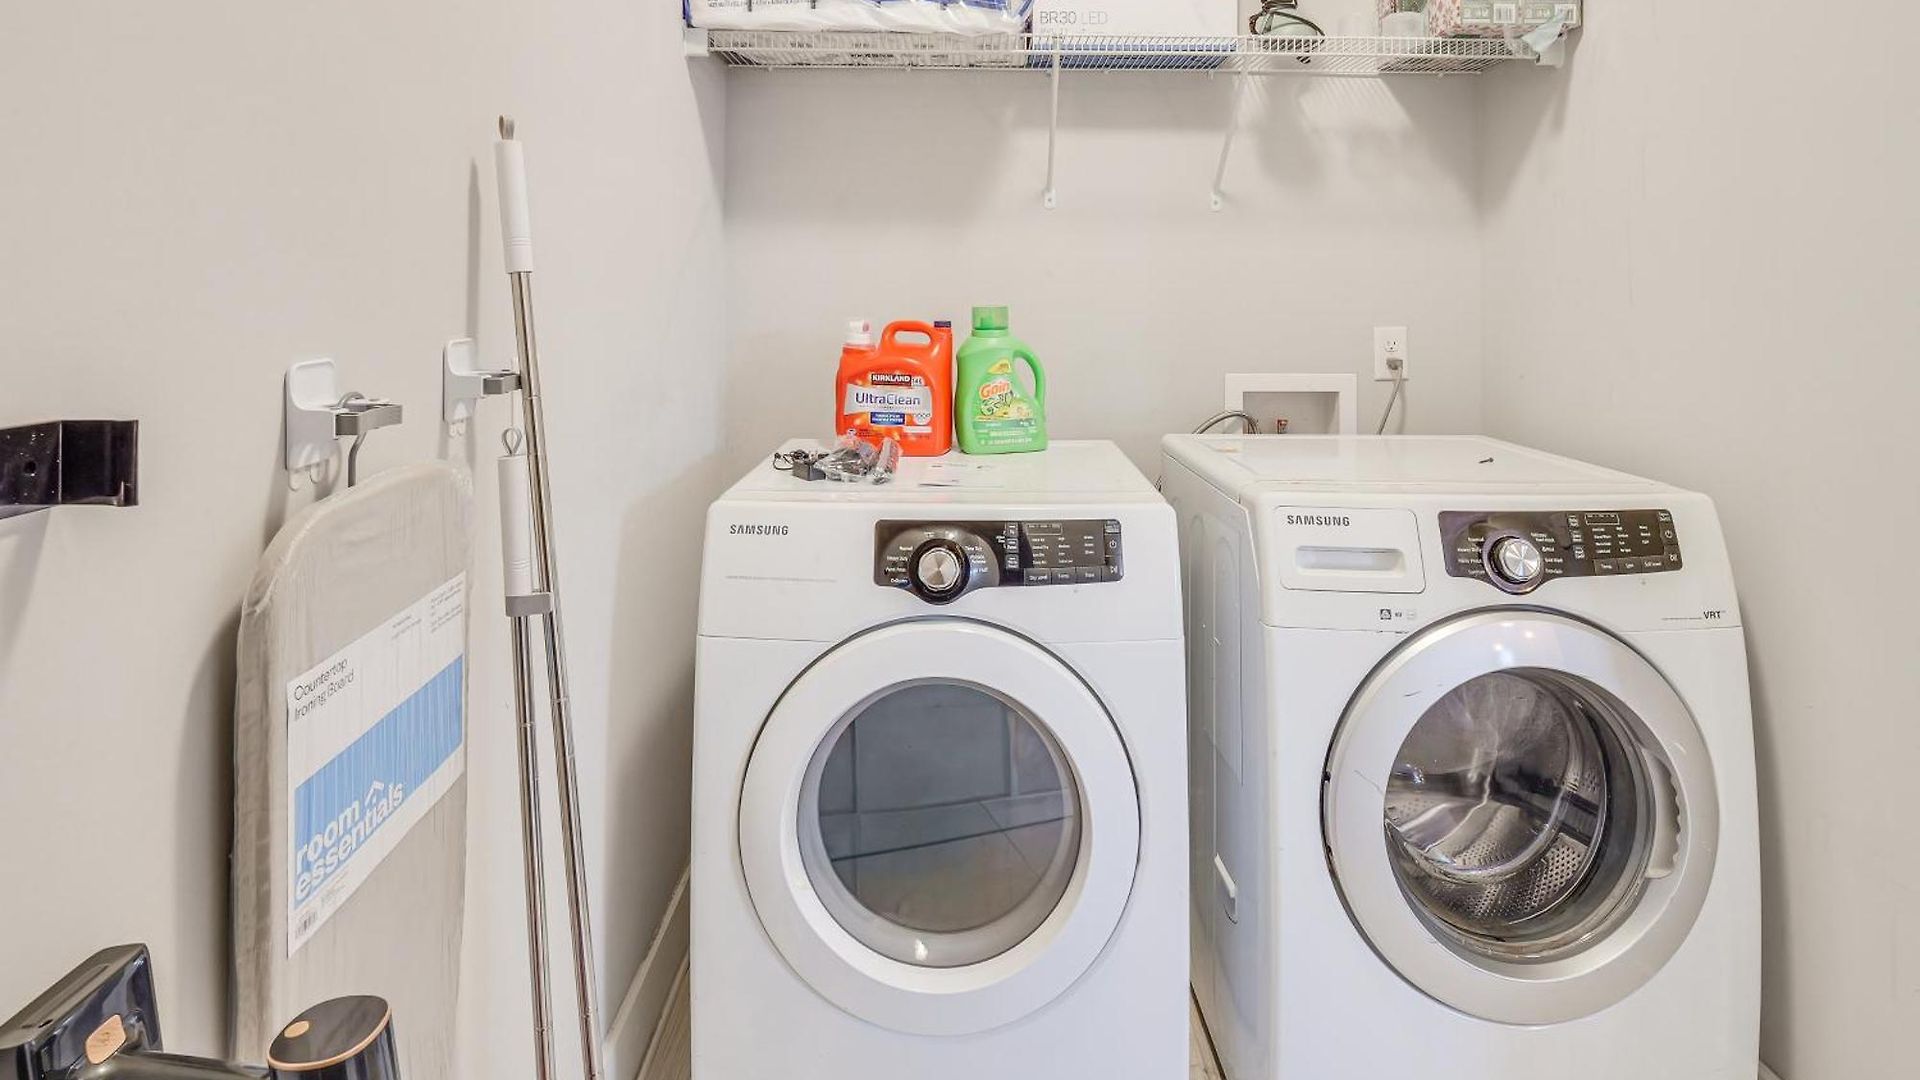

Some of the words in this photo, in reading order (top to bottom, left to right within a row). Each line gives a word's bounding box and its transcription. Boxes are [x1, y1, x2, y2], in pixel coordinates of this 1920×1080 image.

[1039, 11, 1077, 25] BR30
[1080, 11, 1108, 25] LED
[872, 374, 911, 382] KIRKLAND
[980, 382, 1010, 399] Gain
[855, 392, 920, 405] UltraClean
[1287, 515, 1350, 527] SAMSUNG
[729, 524, 789, 536] SAMSUNG
[294, 659, 348, 701] Countertop
[295, 691, 327, 721] Ironing
[328, 668, 354, 697] Board
[295, 783, 404, 902] essentials
[296, 800, 360, 875] room
